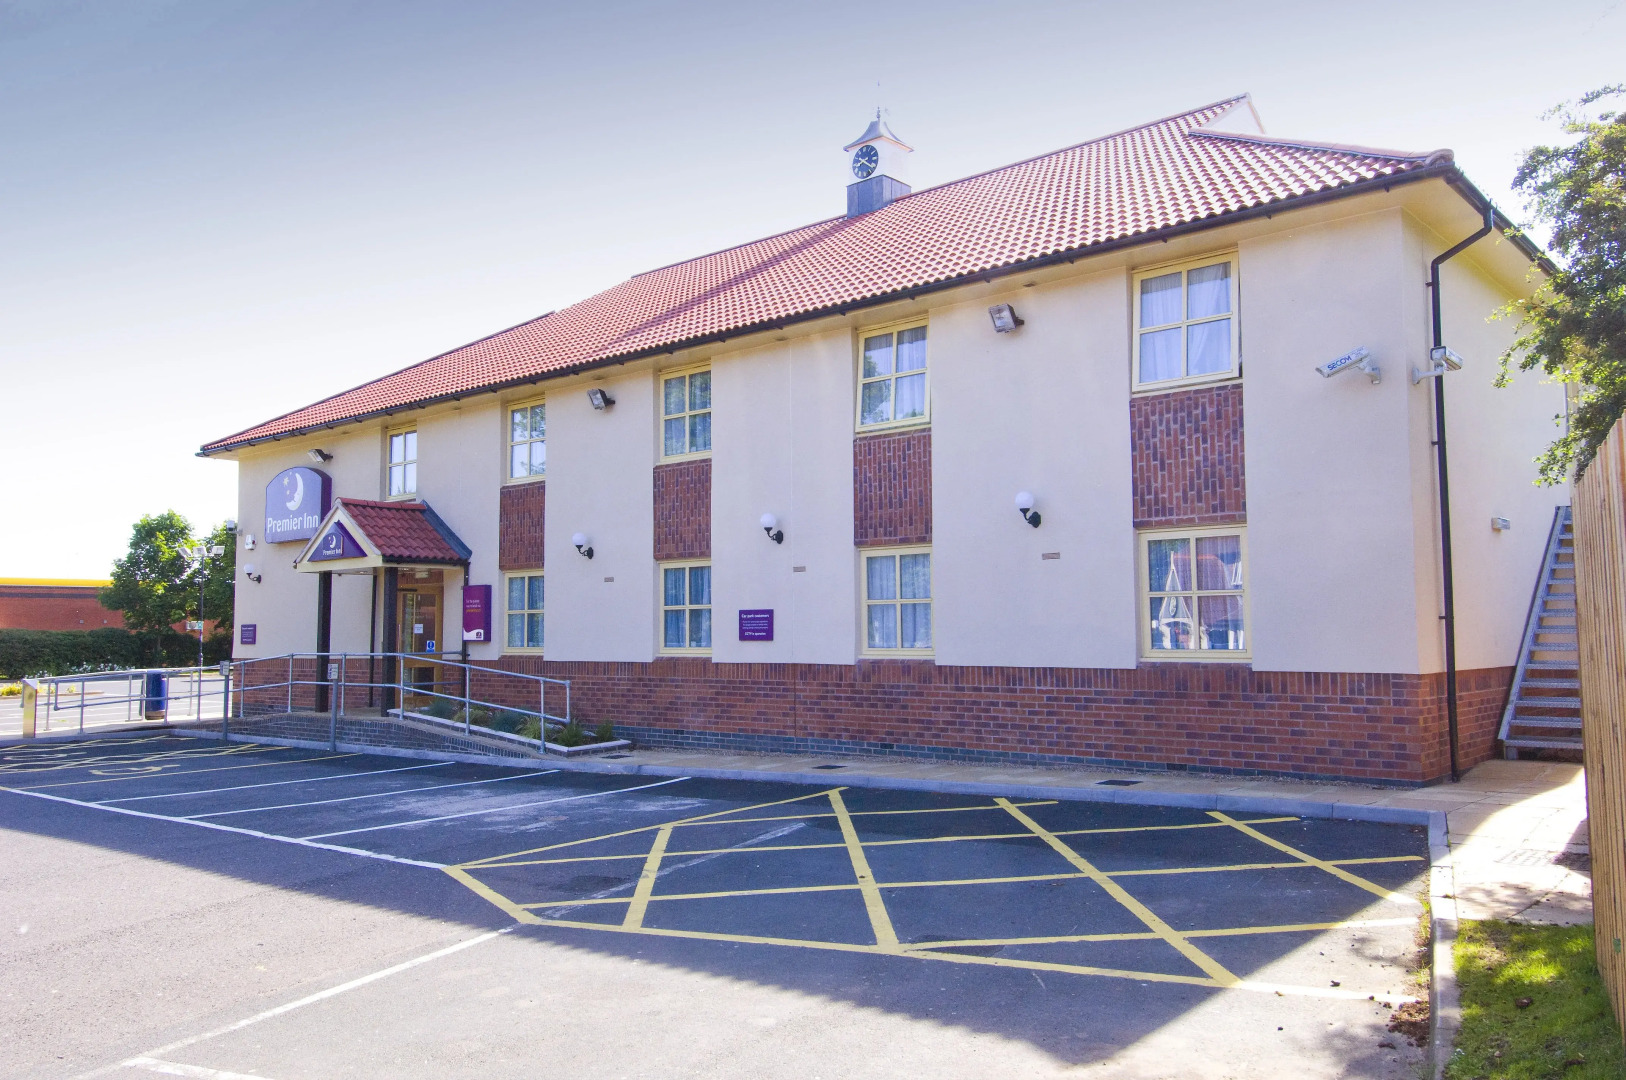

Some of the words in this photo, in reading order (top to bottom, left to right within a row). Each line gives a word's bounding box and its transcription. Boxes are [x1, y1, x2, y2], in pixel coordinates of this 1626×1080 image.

[1327, 355, 1352, 371] SECOM
[267, 515, 302, 533] Premier
[304, 513, 318, 528] Inn
